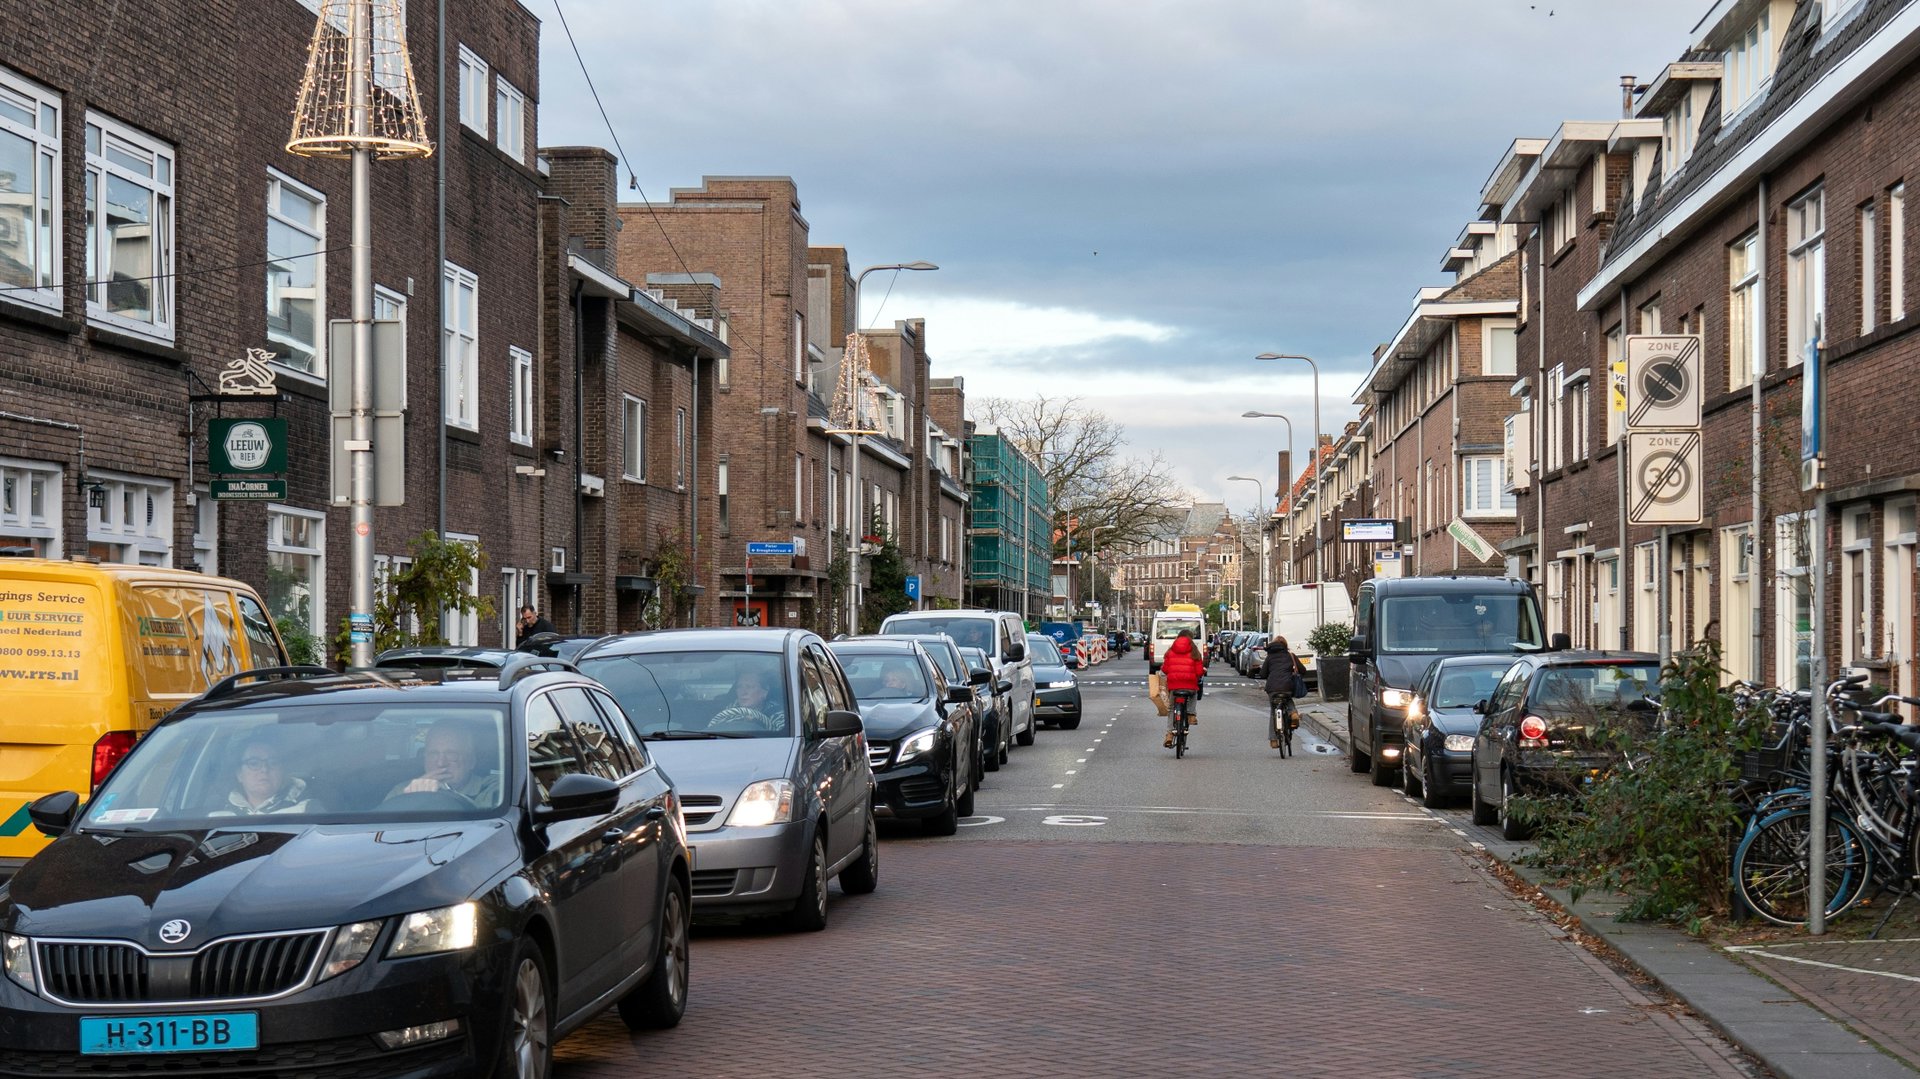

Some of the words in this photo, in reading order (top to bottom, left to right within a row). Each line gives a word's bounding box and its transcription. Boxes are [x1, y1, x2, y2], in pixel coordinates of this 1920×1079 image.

[1648, 343, 1680, 351] ZONE
[230, 440, 265, 451] LEEUW
[1649, 438, 1681, 446] ZONE
[240, 452, 256, 462] BIER
[1647, 467, 1683, 488] 30
[909, 583, 916, 592] P
[38, 592, 85, 604] Service
[7, 612, 31, 622] UUR
[34, 613, 84, 623] SERVICE
[24, 628, 82, 637] Nederland
[27, 649, 80, 658] 099.13.13
[106, 1019, 231, 1047] H-311-BB
